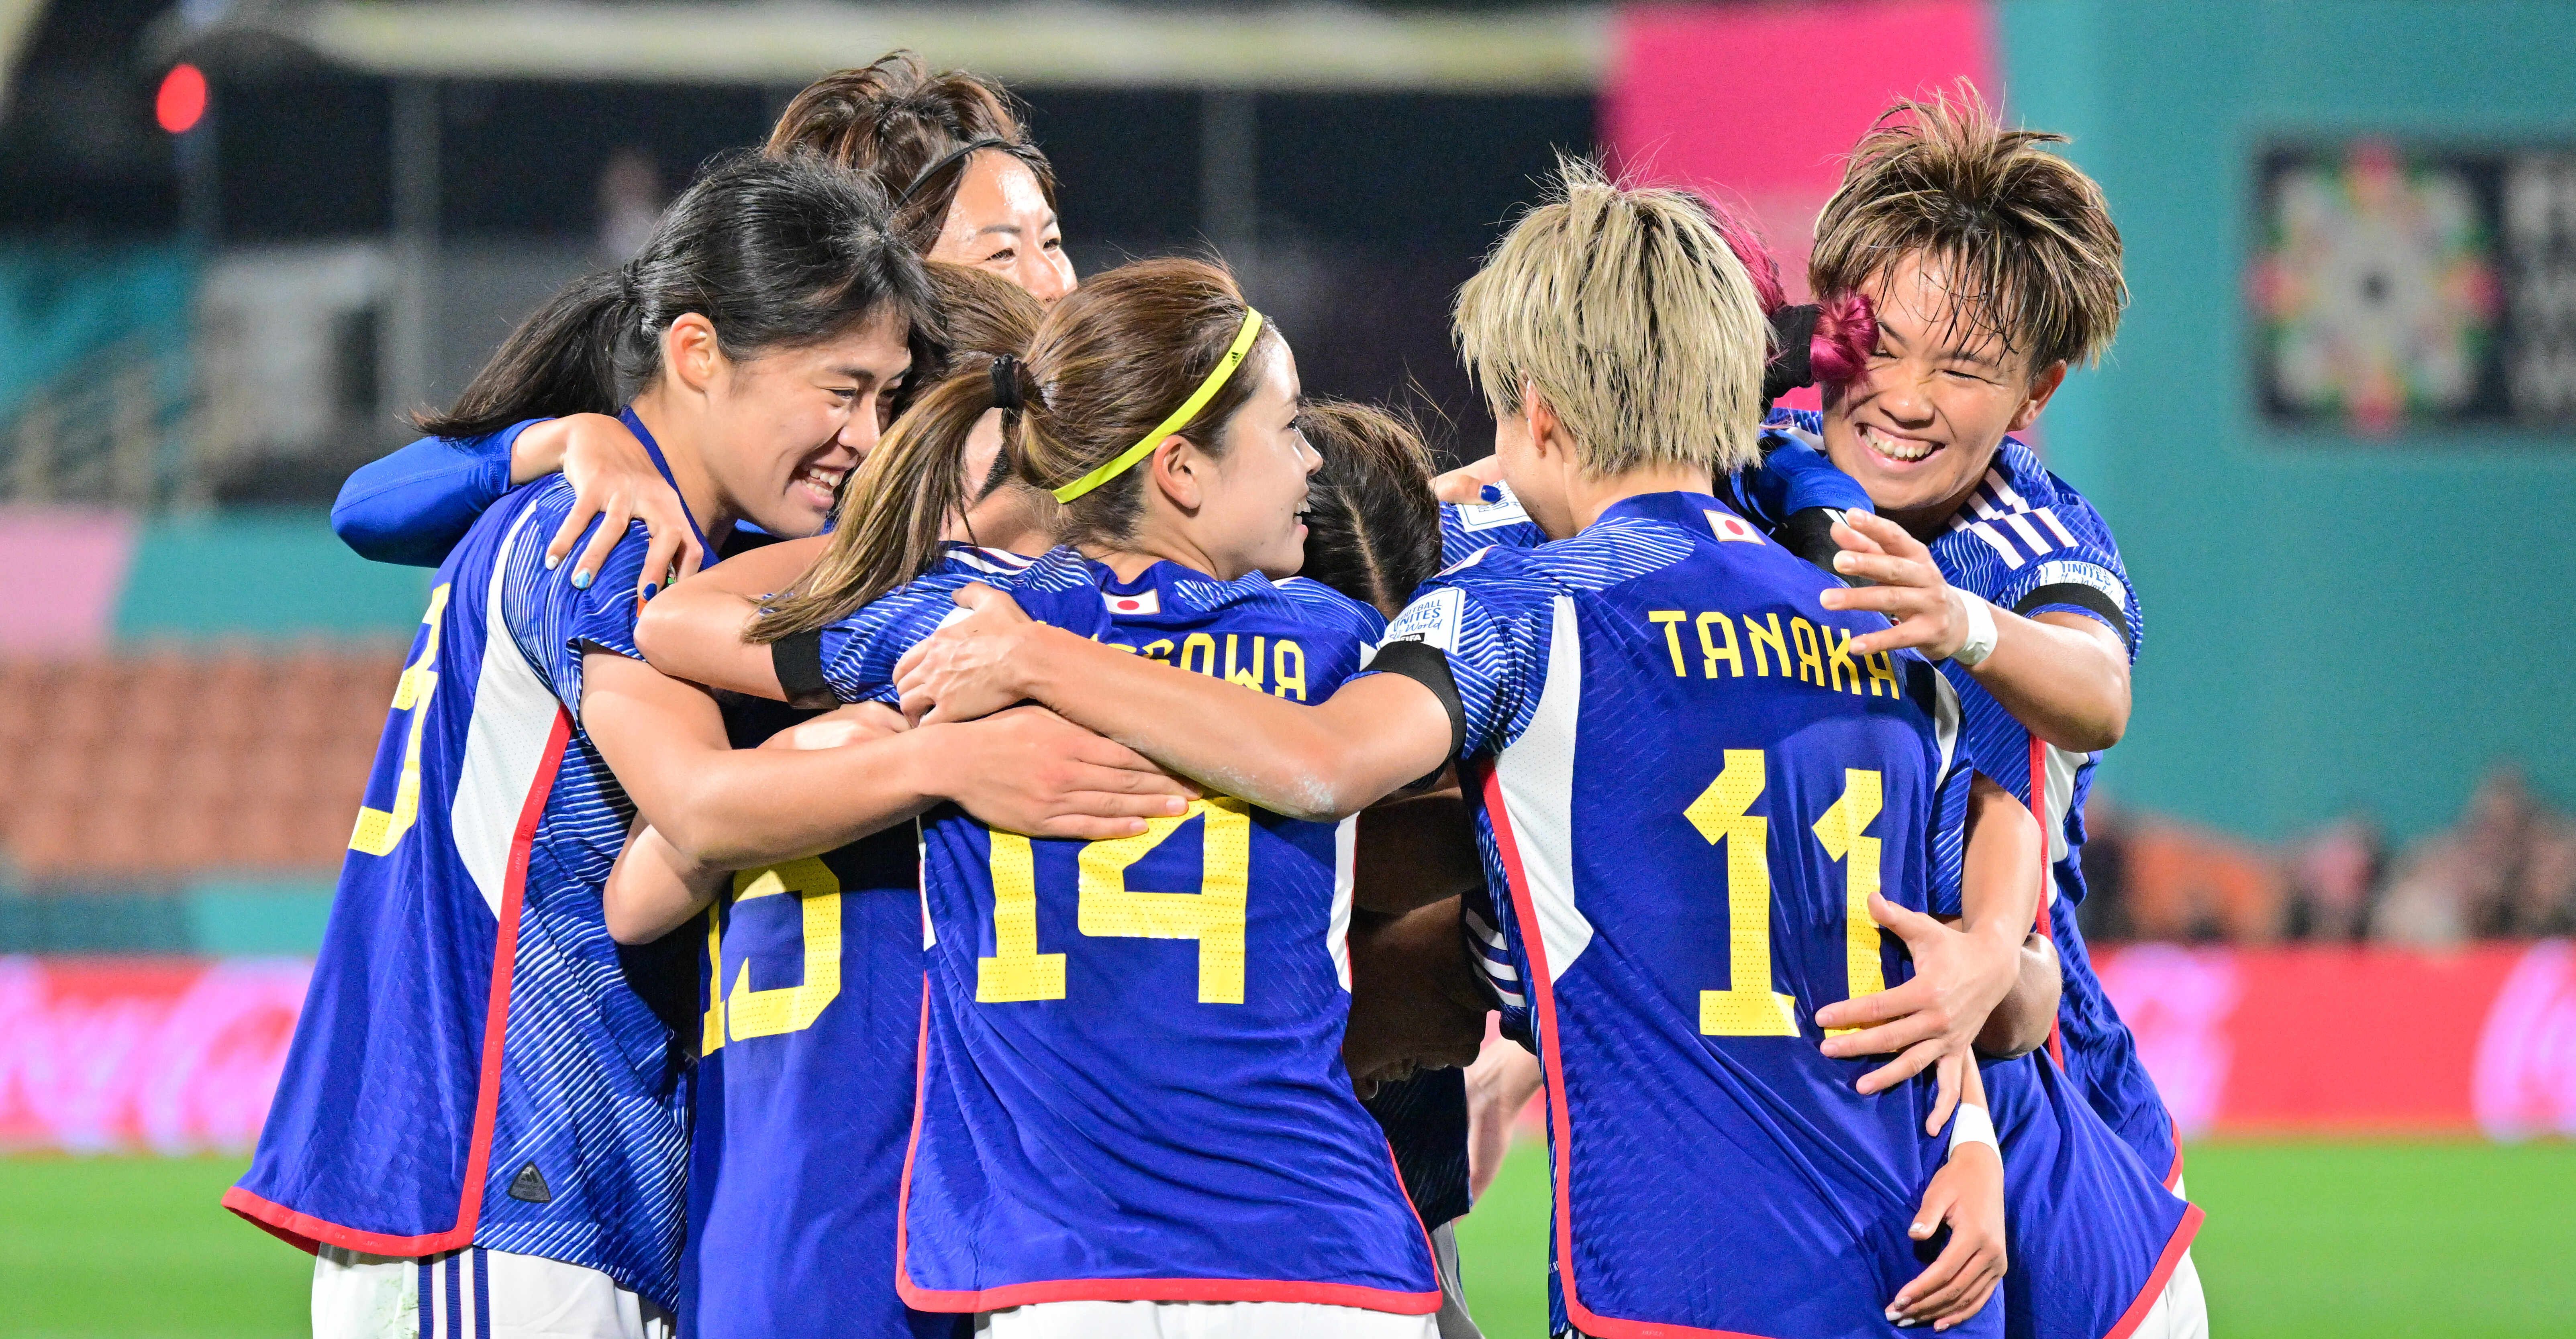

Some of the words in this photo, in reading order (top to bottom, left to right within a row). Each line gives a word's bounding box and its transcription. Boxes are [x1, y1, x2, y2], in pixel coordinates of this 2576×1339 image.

[1394, 607, 1441, 632] UNITES
[1405, 619, 1443, 632] World
[1648, 610, 1900, 700] TANAKA
[976, 794, 1250, 1004] 14
[1683, 749, 1897, 1038] 11
